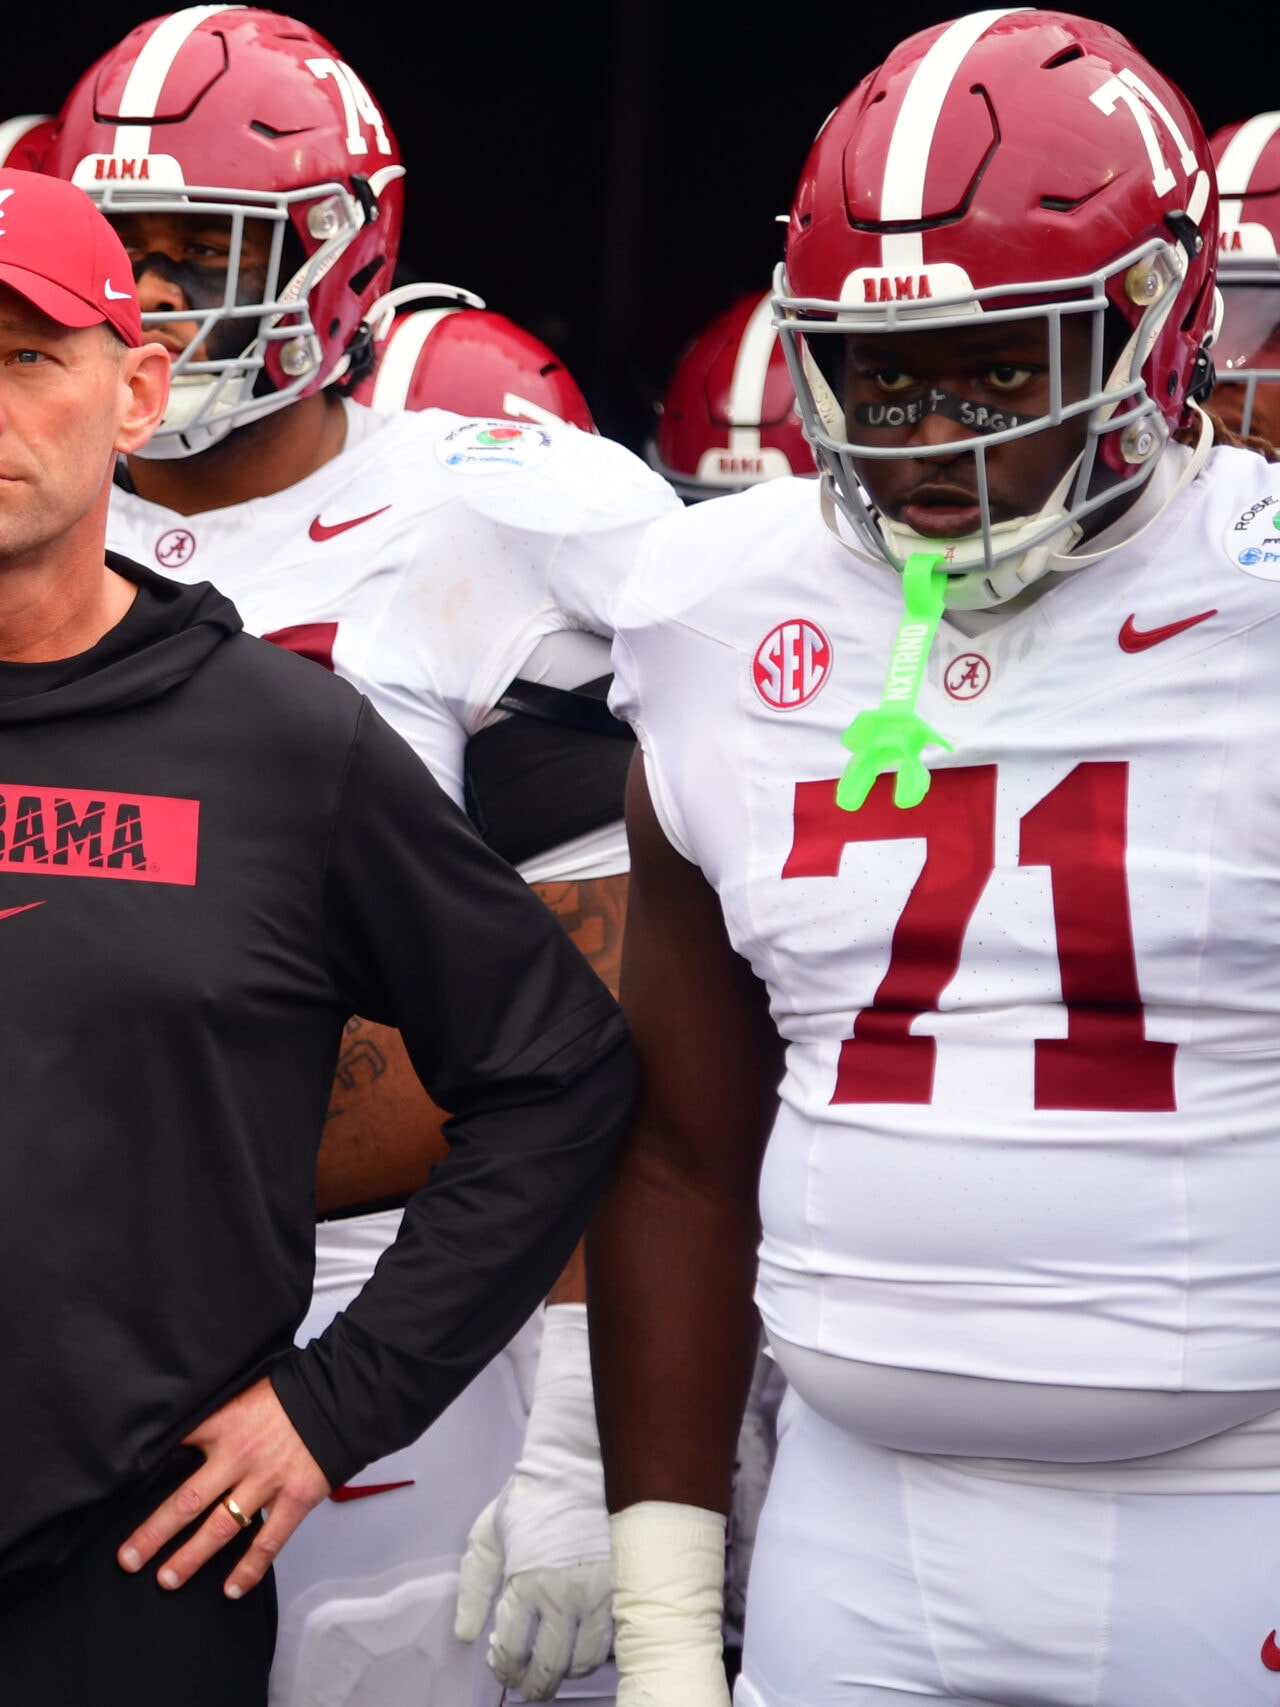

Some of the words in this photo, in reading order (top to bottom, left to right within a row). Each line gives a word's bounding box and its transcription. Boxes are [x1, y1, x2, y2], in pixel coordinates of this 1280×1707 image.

[305, 57, 392, 156] 74
[1088, 67, 1199, 199] 71
[94, 158, 150, 180] BAMA
[862, 274, 933, 303] BAMA
[1234, 495, 1279, 531] ROSE
[756, 623, 825, 704] SEC
[885, 622, 929, 701] NXTRND
[781, 761, 1177, 1112] 71
